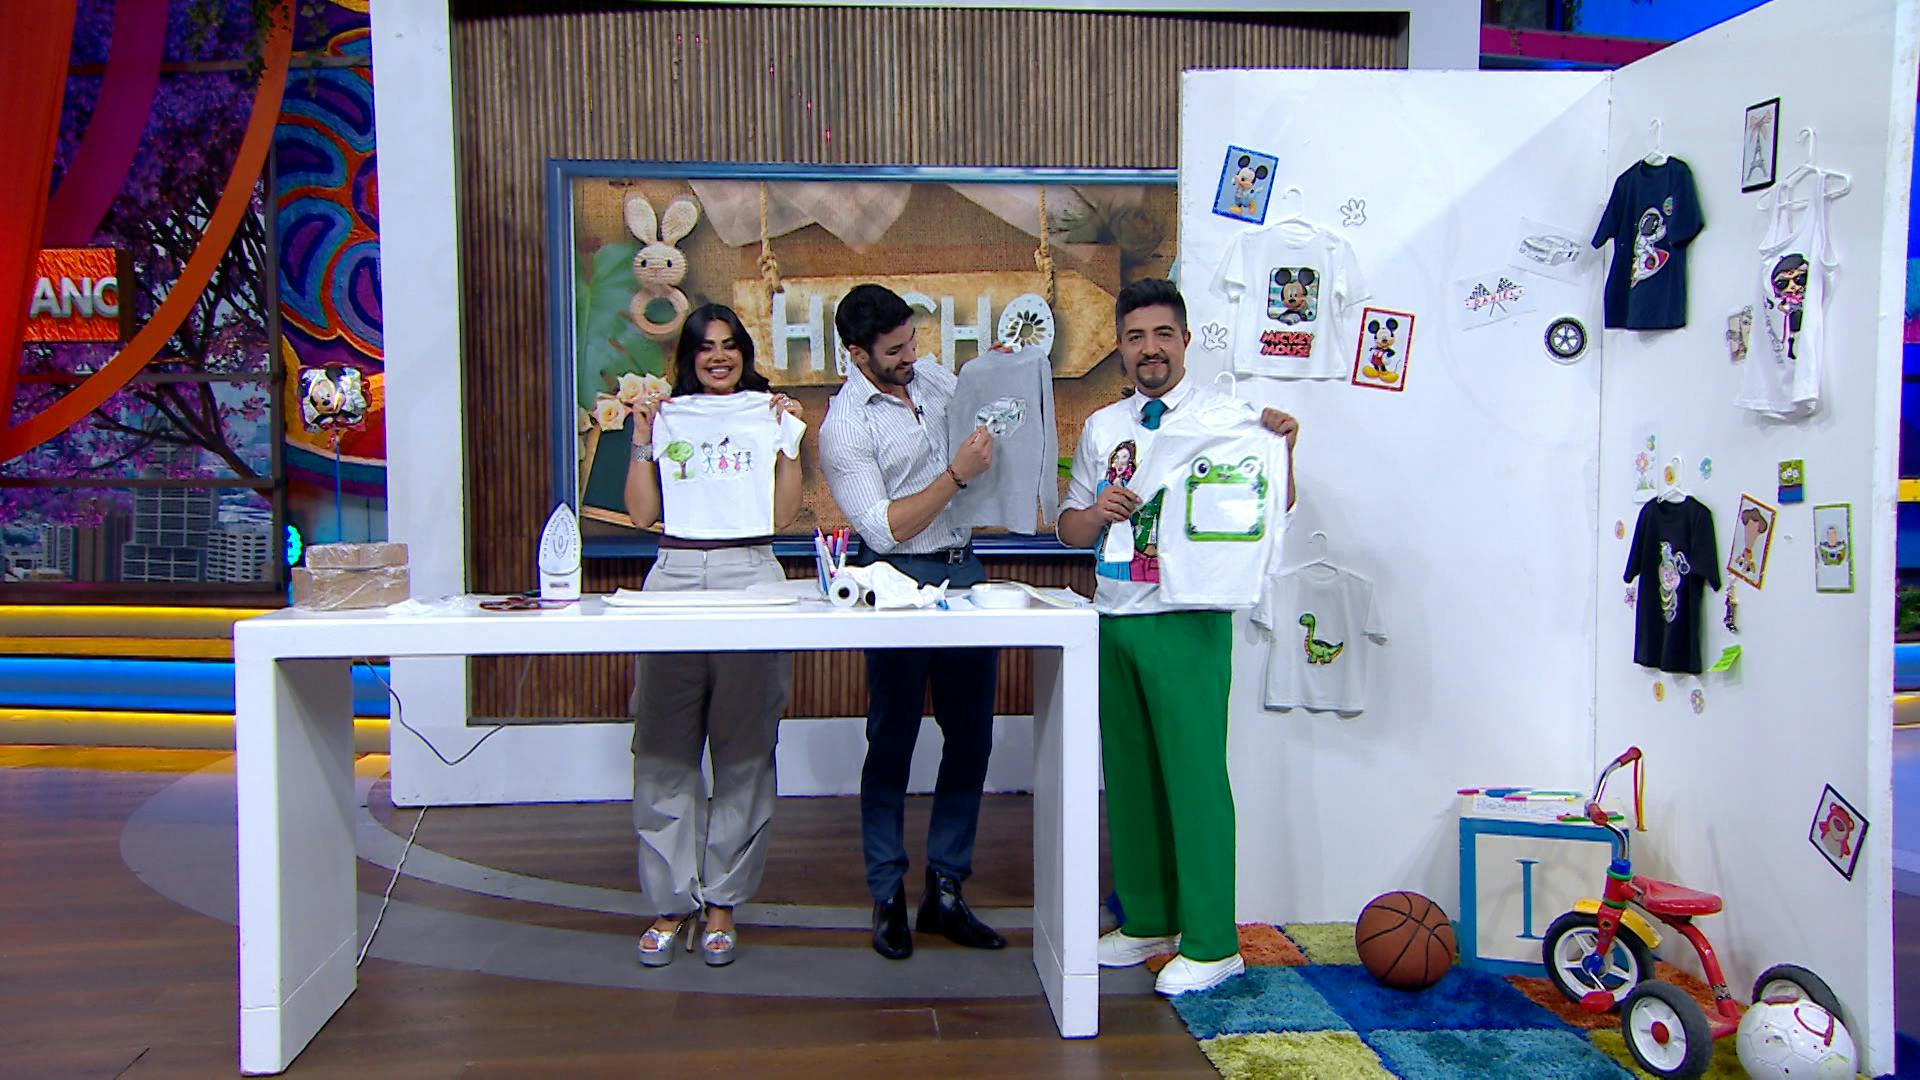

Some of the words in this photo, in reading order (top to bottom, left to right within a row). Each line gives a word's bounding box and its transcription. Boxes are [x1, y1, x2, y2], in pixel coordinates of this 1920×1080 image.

[772, 292, 1055, 376] HHO
[1260, 330, 1314, 345] MICKEY
[1260, 344, 1311, 357] MOUSE
